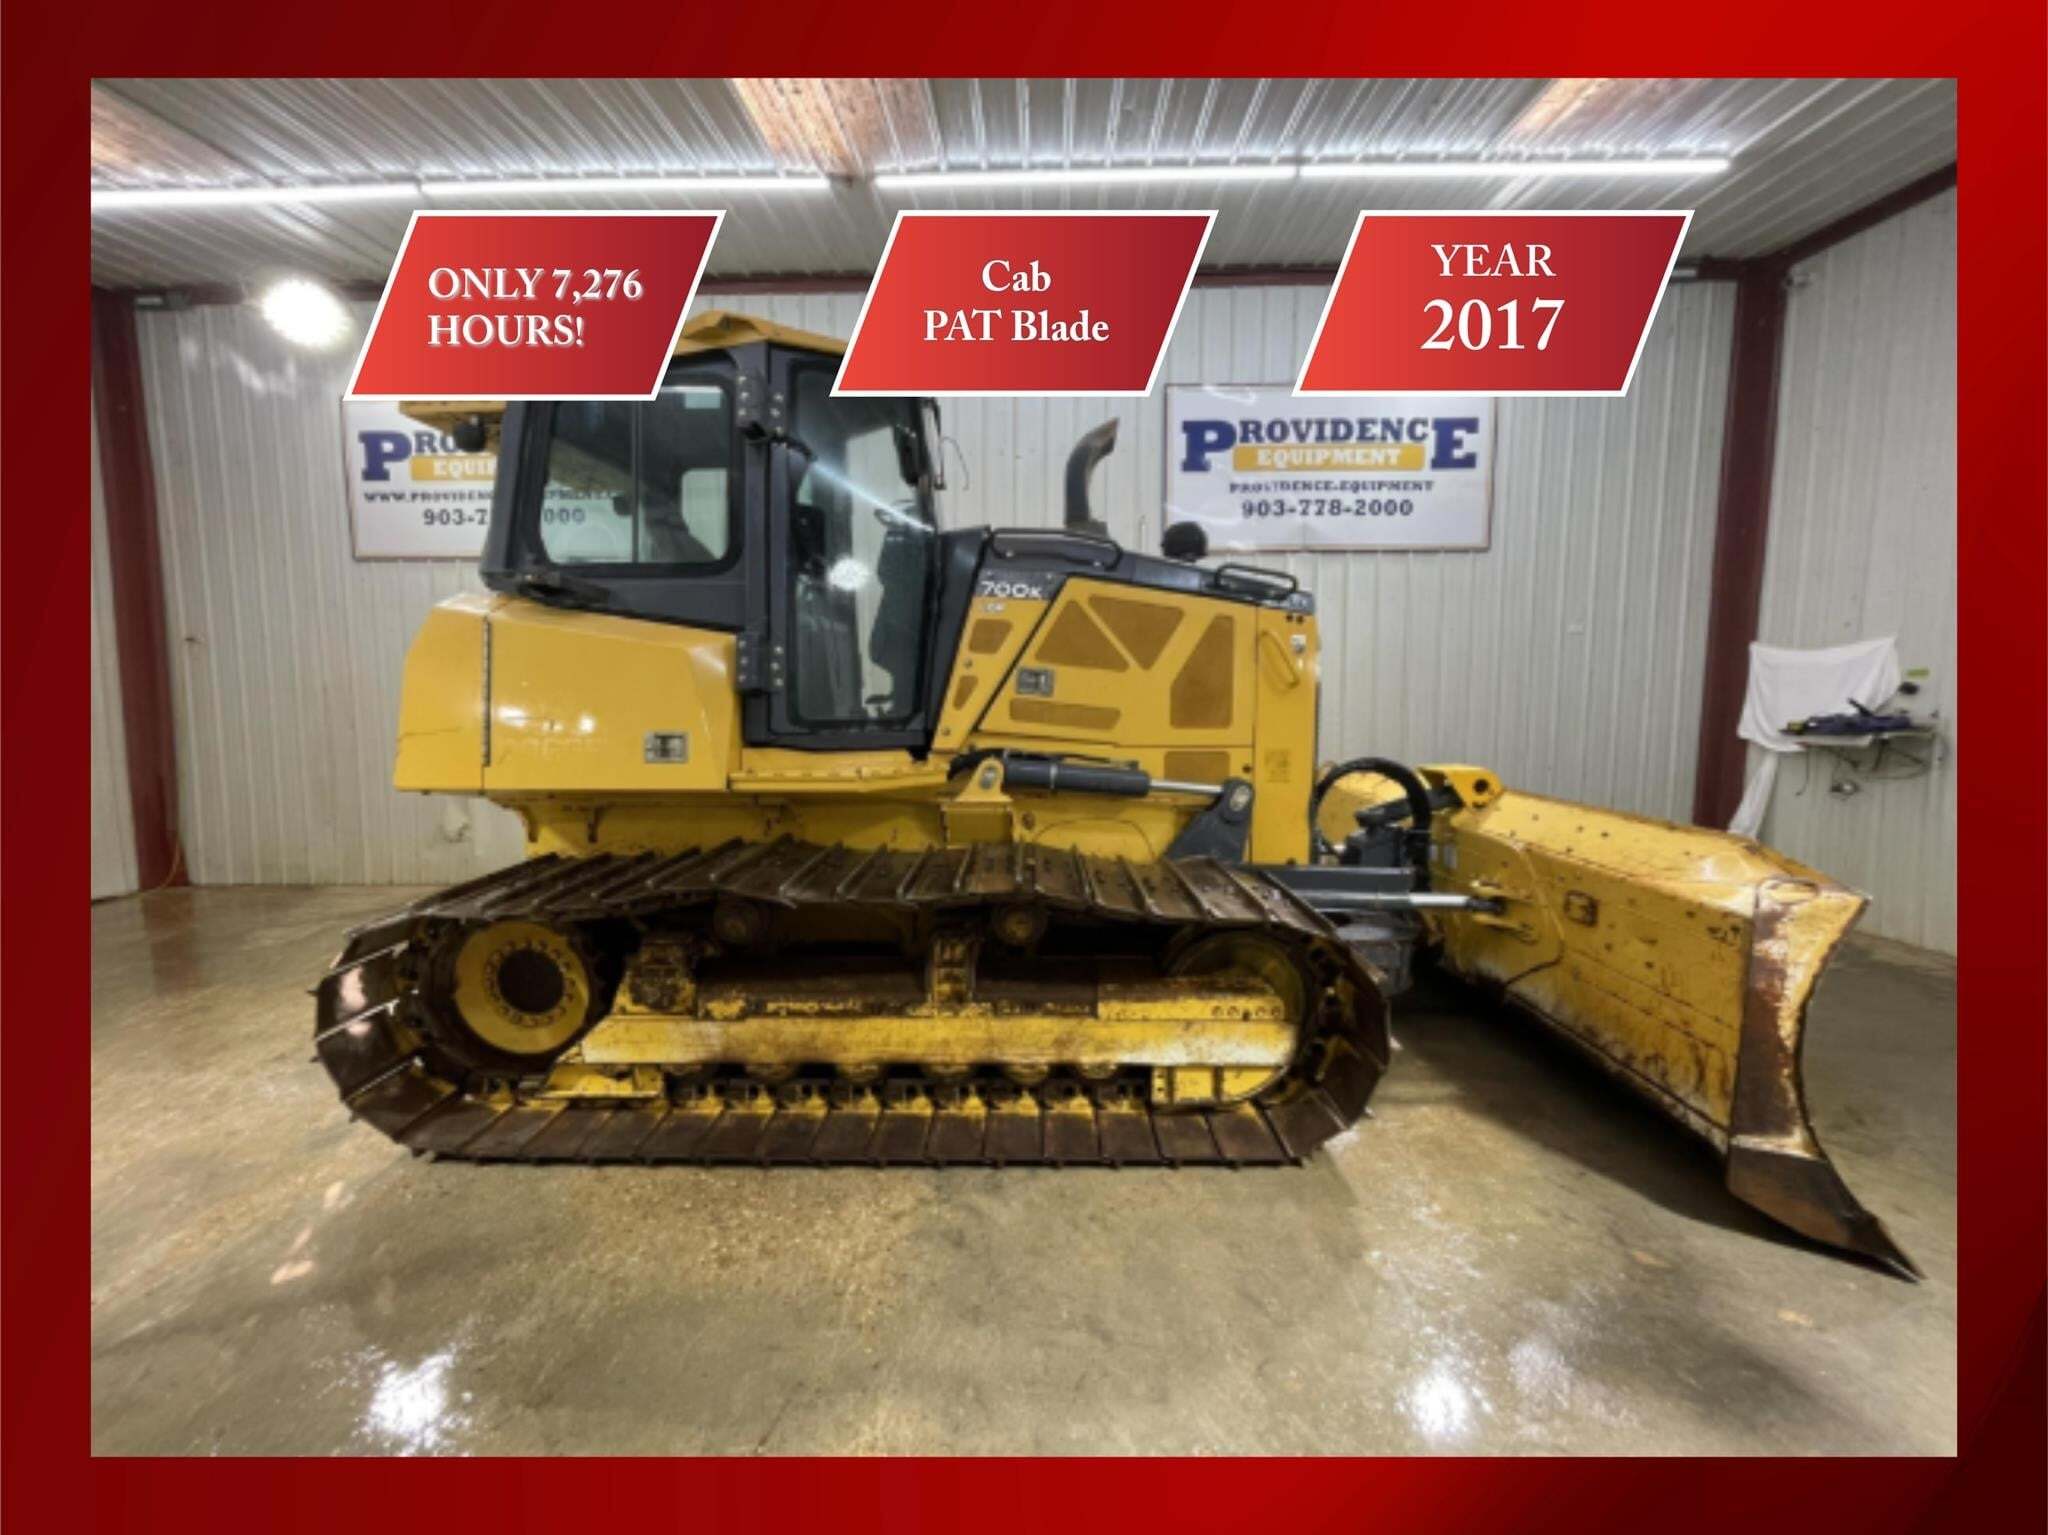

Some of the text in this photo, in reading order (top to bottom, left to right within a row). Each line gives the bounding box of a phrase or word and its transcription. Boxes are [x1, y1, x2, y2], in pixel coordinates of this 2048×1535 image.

[1180, 416, 1480, 473] PROVIDENCE
[1257, 448, 1401, 469] EQUIPMENT
[1242, 499, 1414, 517] 903-778-2000
